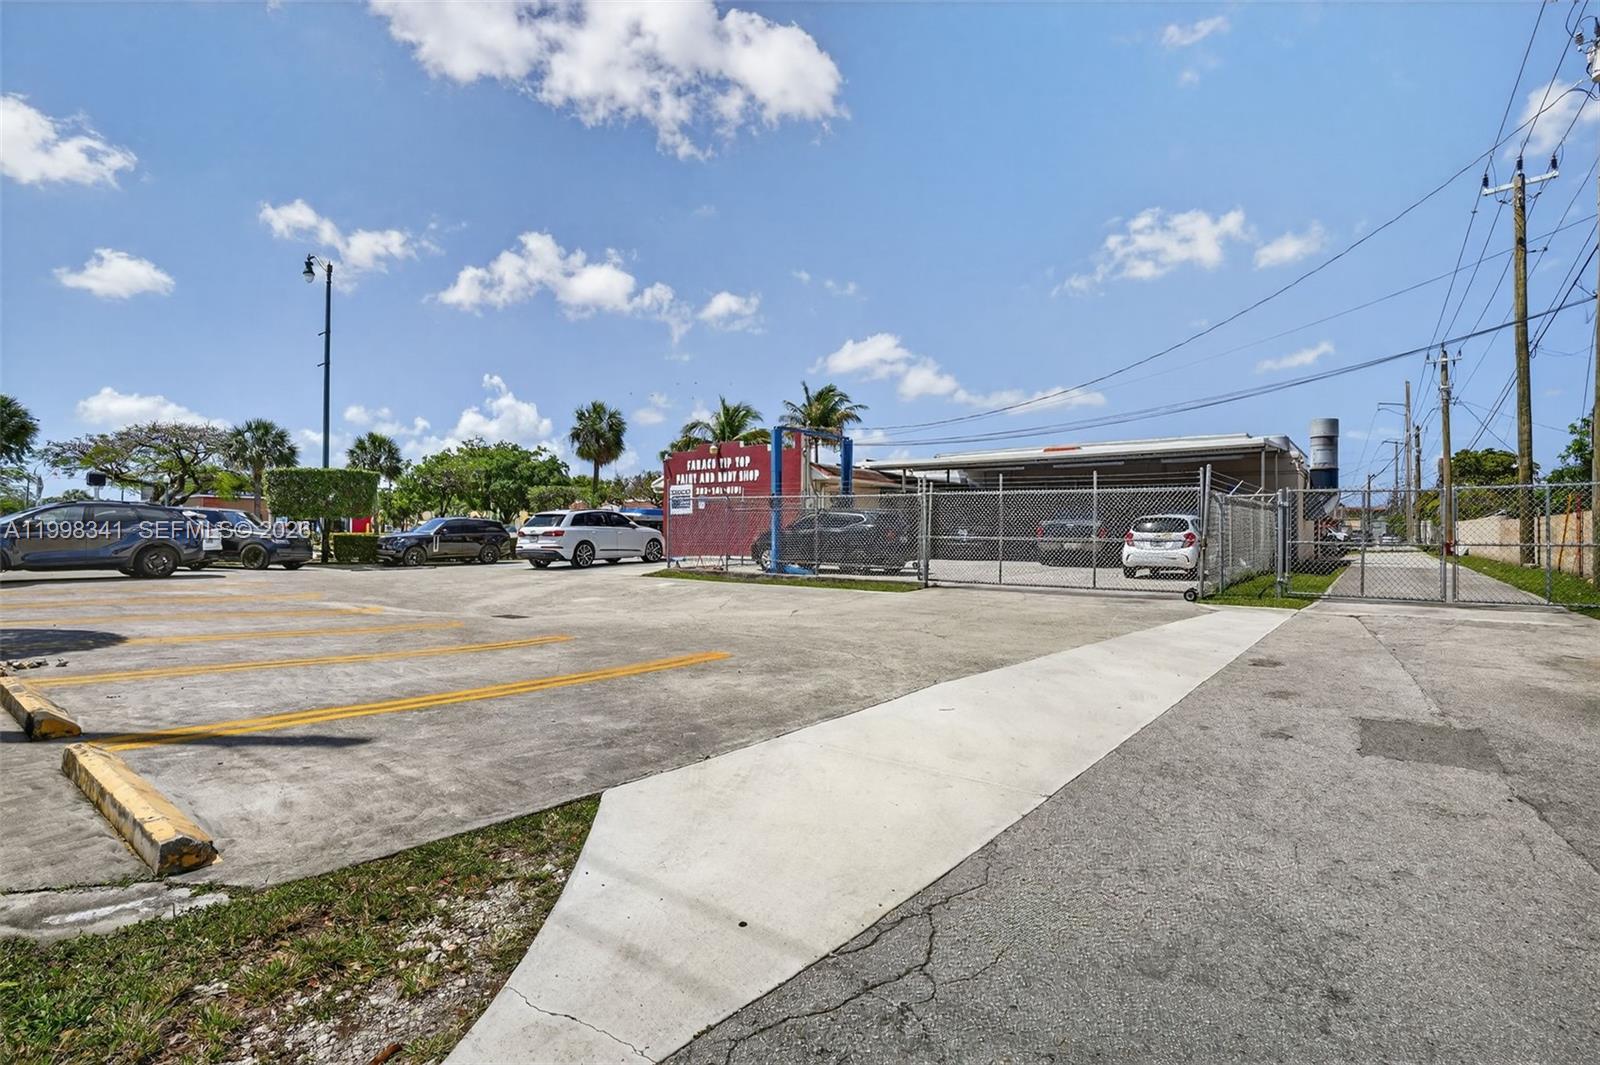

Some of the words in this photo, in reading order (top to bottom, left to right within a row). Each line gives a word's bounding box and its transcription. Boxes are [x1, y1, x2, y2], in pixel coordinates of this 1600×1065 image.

[719, 458, 732, 468] TIP
[735, 456, 751, 468] TOP
[676, 473, 697, 485] PAINT
[699, 472, 715, 484] AND
[717, 471, 737, 483] BODY
[739, 469, 760, 482] SHOP
